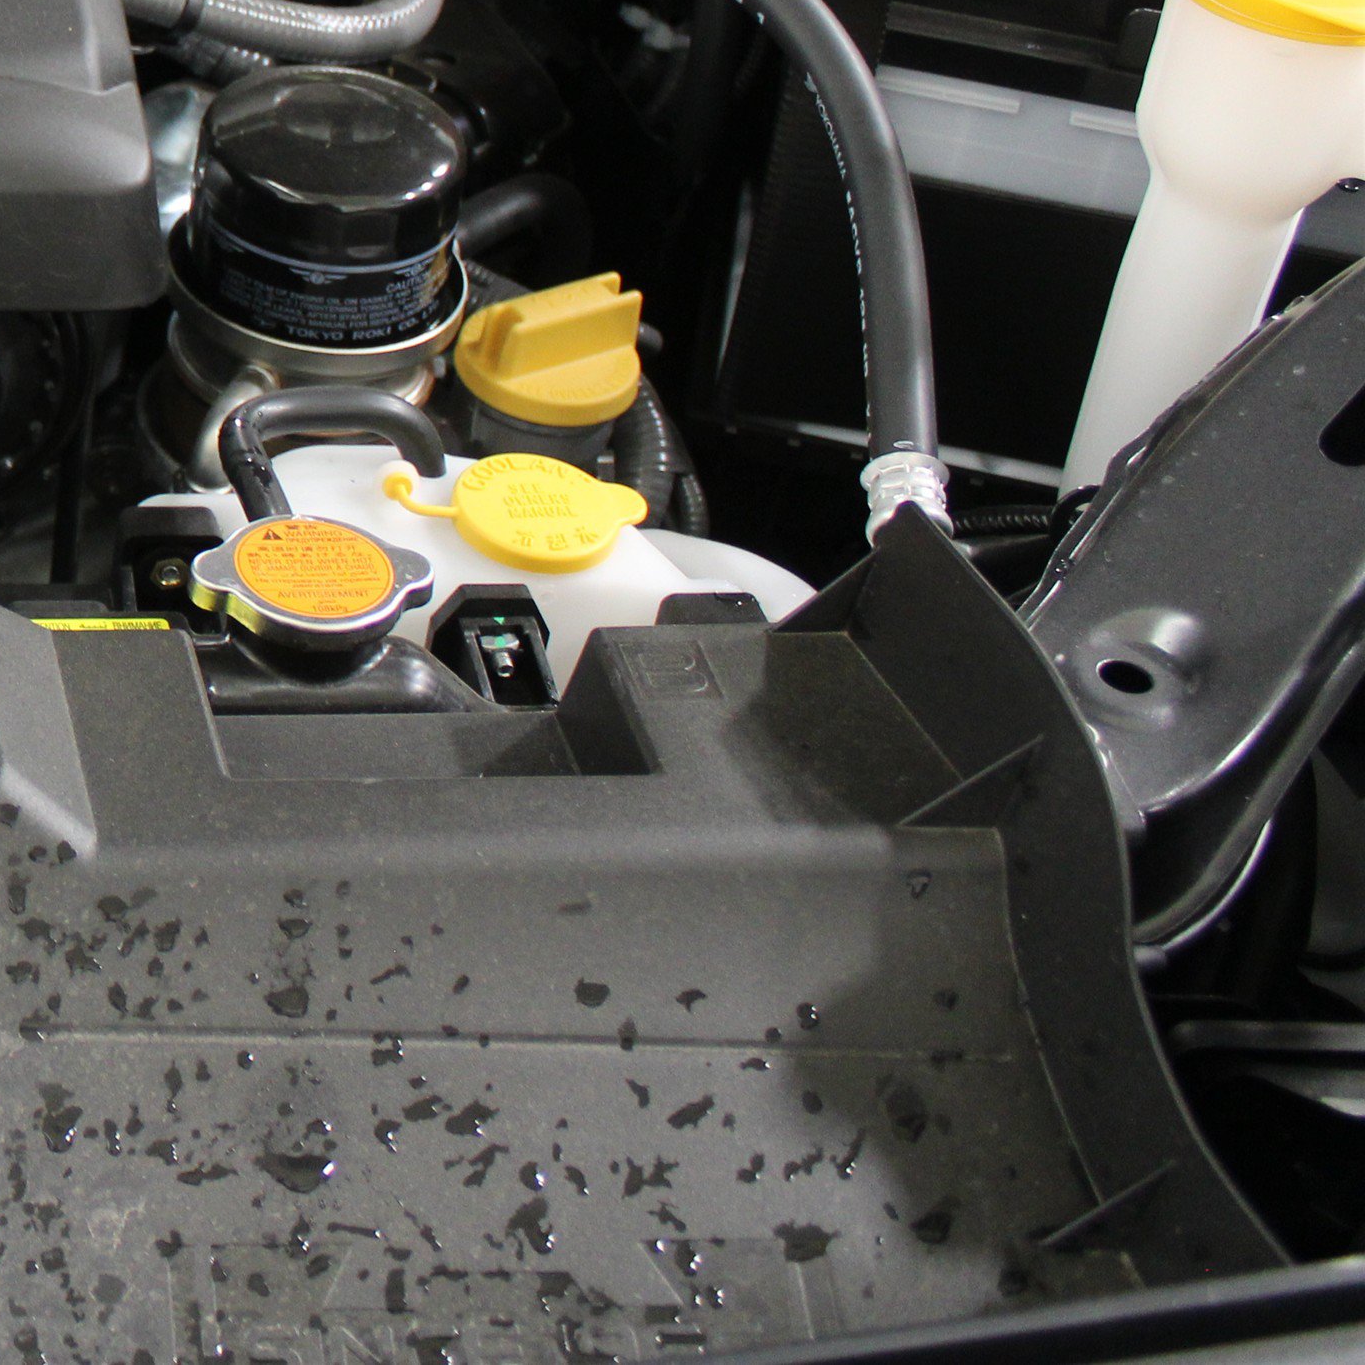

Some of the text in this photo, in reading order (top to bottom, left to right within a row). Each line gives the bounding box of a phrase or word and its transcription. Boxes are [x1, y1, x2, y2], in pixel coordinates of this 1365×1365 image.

[286, 325, 344, 340] TOKYO
[352, 325, 392, 340] ROKI
[284, 529, 343, 538] WARNING
[248, 558, 281, 567] NEVER
[317, 558, 349, 566] WHEN
[352, 556, 374, 565] HOT
[277, 589, 370, 599] AVERTISSEMENT
